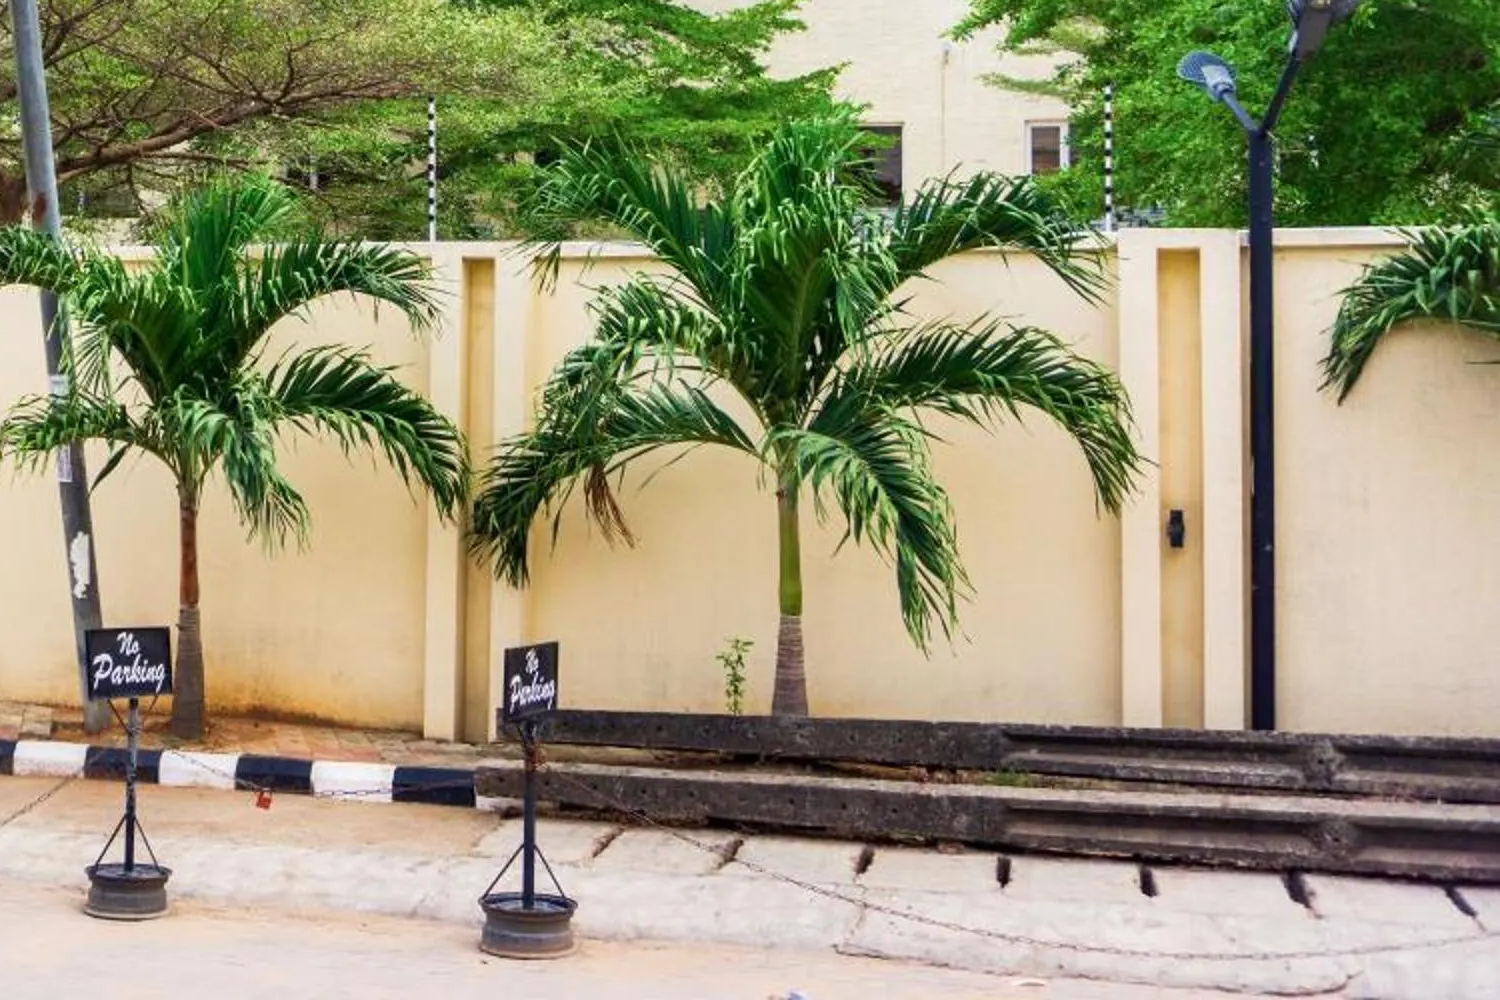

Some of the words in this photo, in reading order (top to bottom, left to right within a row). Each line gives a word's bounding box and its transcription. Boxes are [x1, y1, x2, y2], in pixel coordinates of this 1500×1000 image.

[116, 631, 140, 656] No
[92, 653, 165, 693] Parking
[509, 671, 555, 713] Parking
